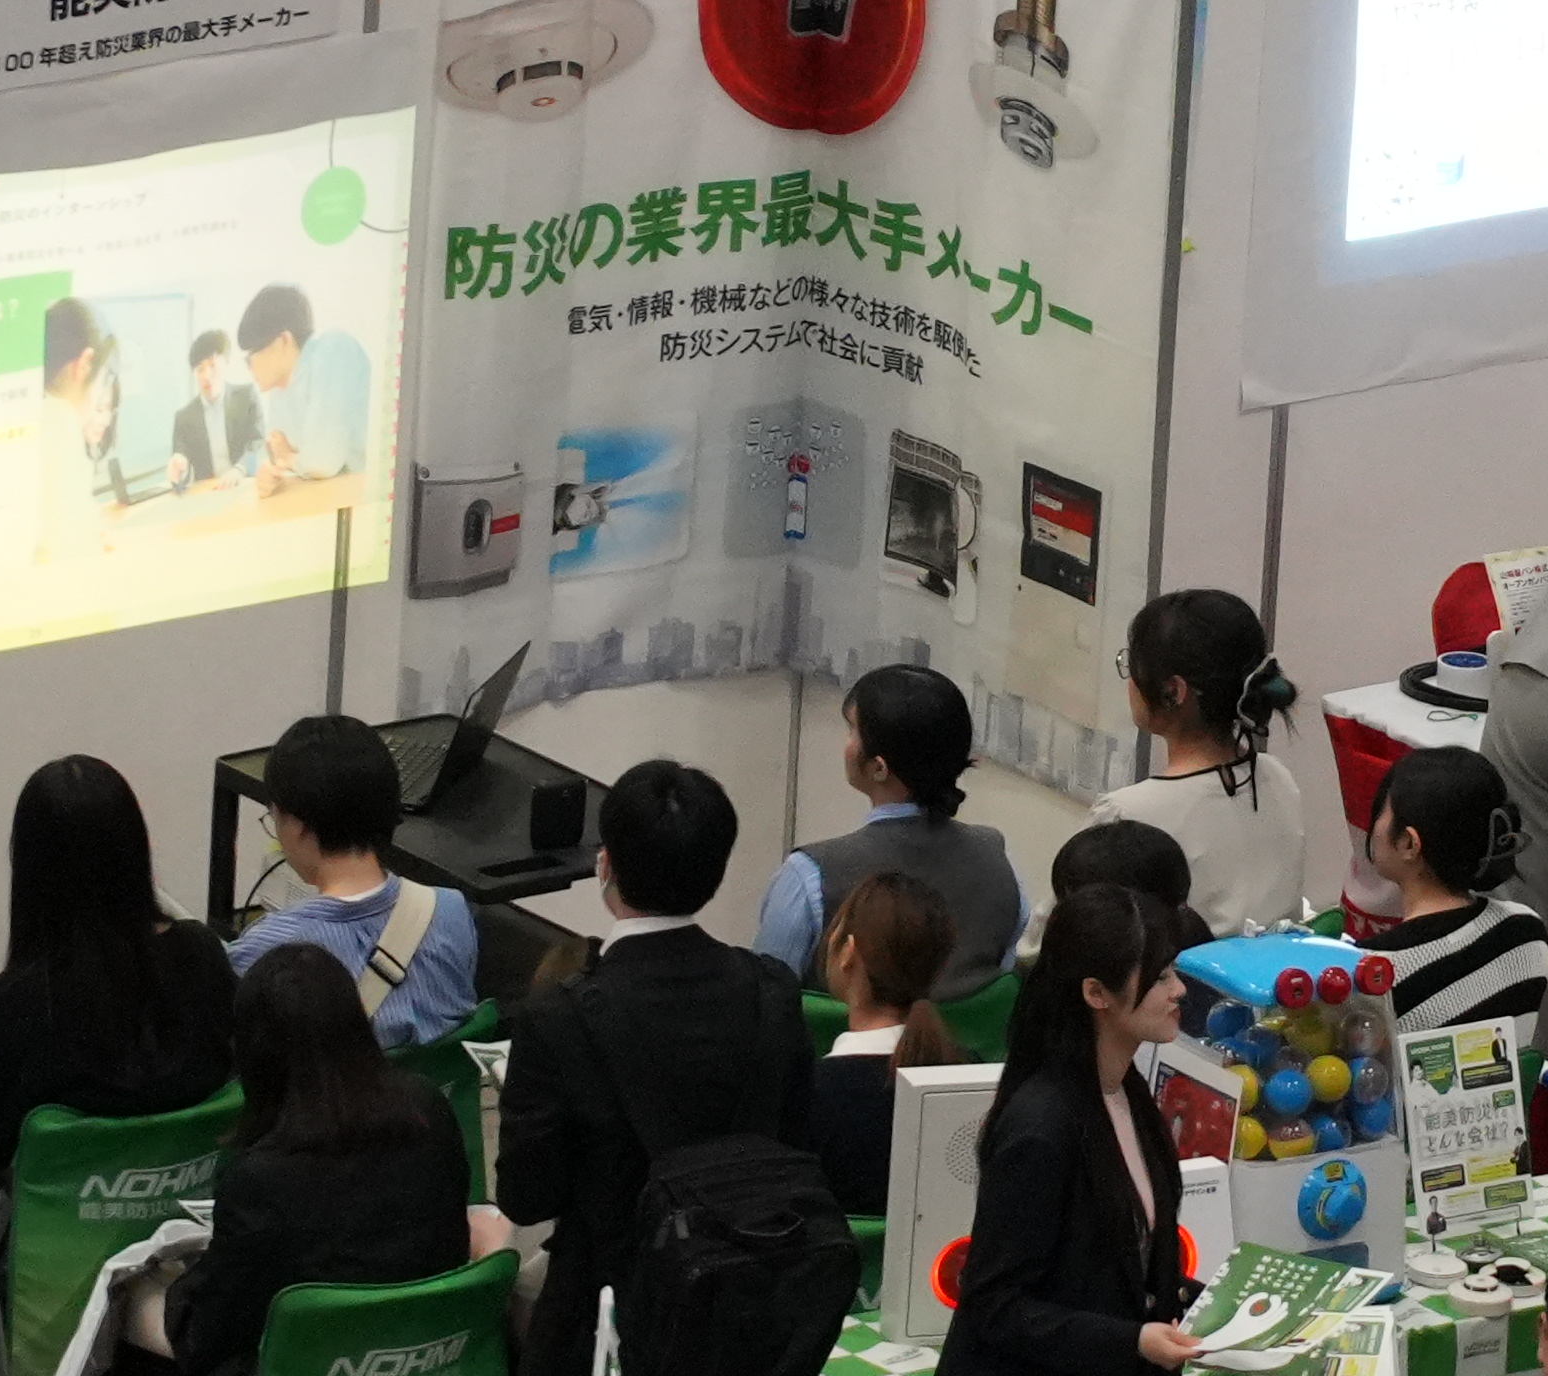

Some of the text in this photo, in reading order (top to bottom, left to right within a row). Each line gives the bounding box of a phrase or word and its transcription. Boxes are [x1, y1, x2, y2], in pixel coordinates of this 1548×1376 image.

[39, 6, 310, 67] 年超え防災業界の最大手メーカー
[443, 169, 1095, 338] 防災の業界最大手メーカー
[658, 319, 925, 385] 防災システムで社会に貢献
